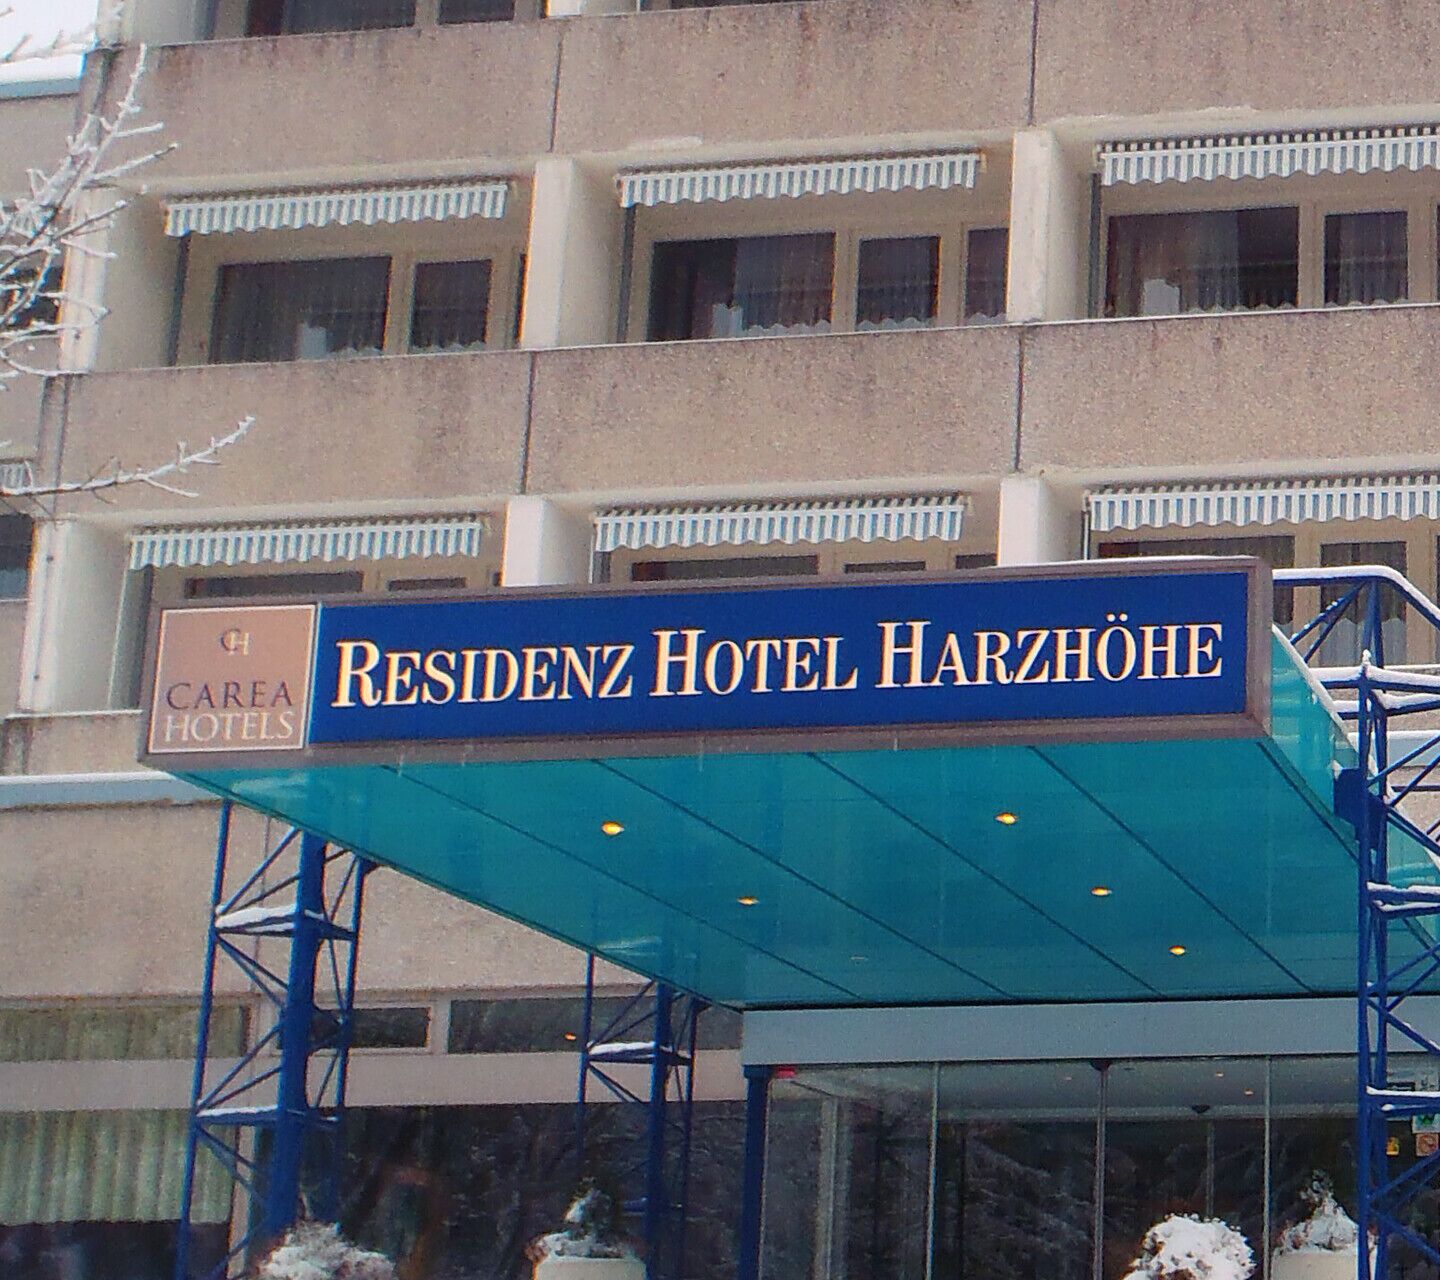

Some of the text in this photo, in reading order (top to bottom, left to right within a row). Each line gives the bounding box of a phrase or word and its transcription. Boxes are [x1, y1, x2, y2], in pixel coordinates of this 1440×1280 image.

[330, 612, 1224, 709] RESIDENZ HOTEL HARZHÖHE
[166, 680, 294, 710] CAREA
[165, 710, 297, 743] HOTELS
